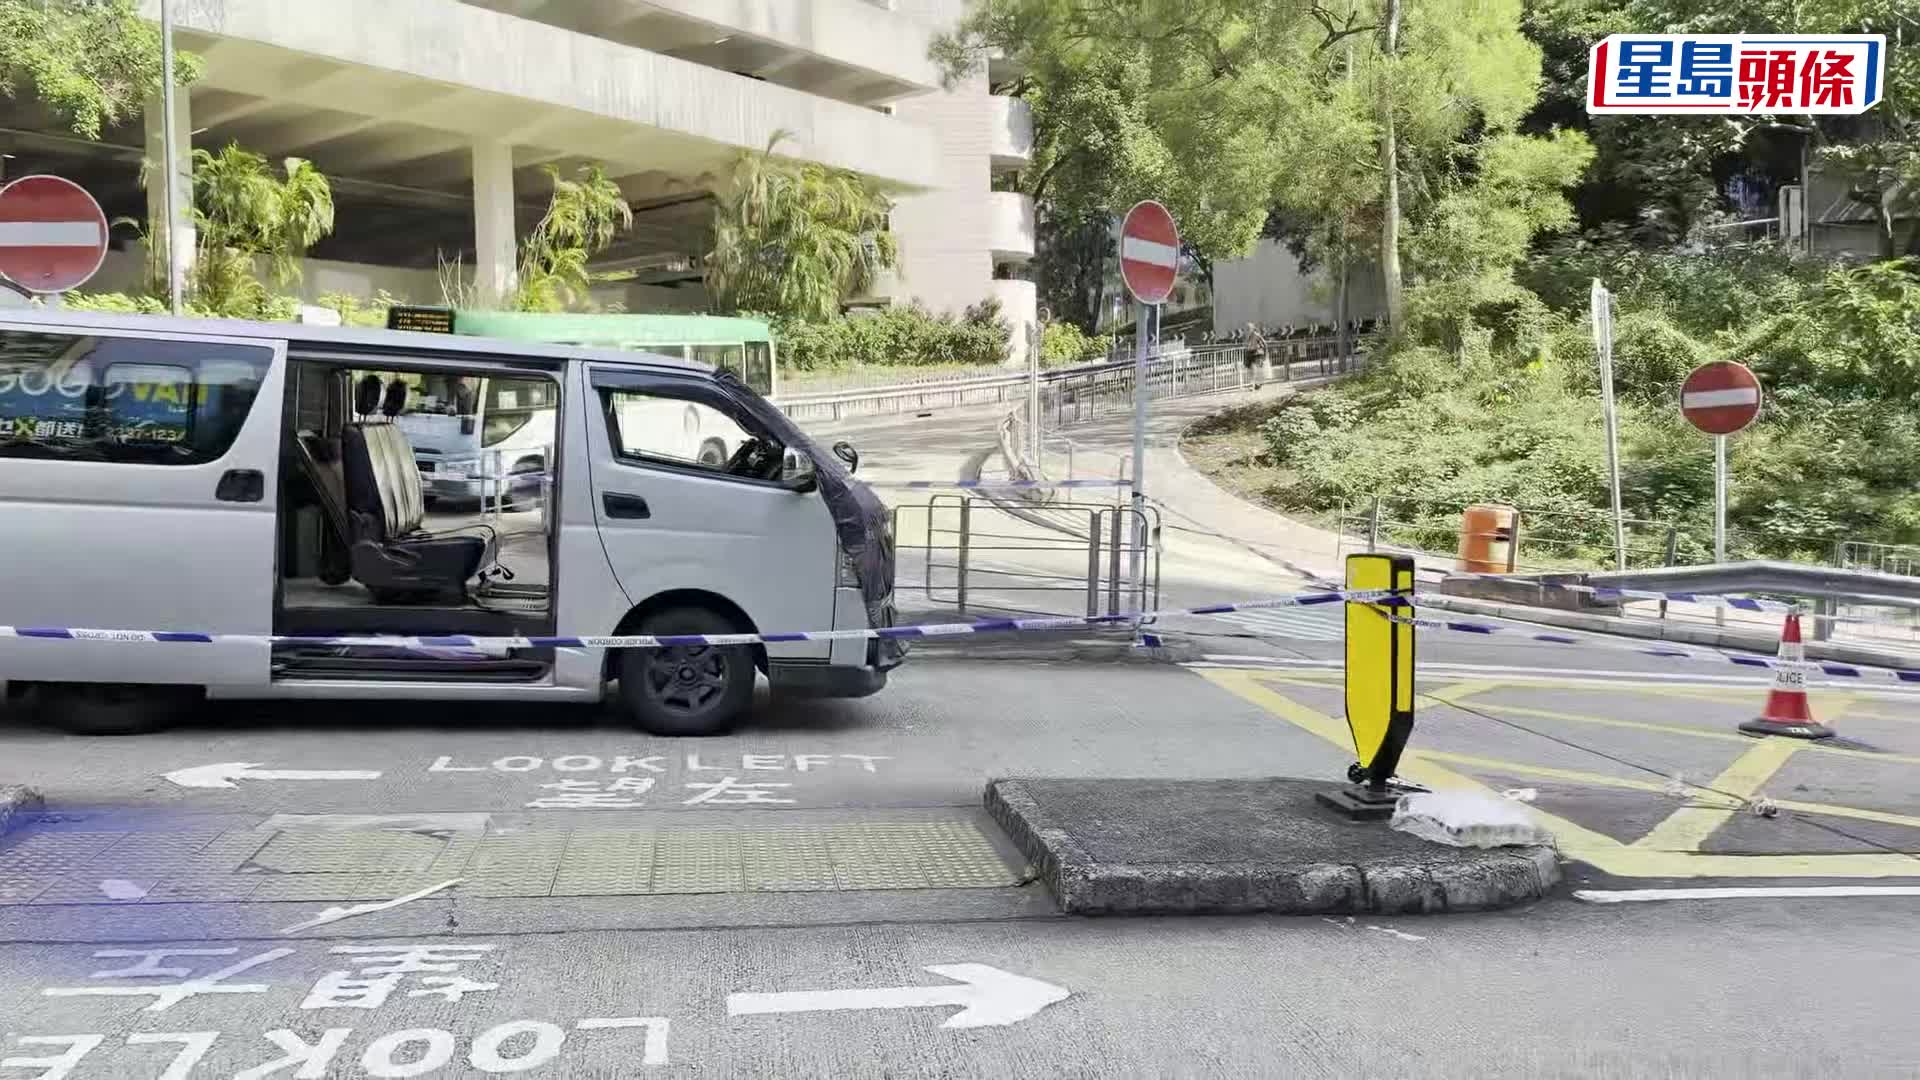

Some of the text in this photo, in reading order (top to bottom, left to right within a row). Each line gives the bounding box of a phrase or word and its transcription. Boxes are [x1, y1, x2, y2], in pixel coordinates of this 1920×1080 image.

[428, 754, 896, 773] LOOK LEFT
[233, 1017, 670, 1080] LOOK
